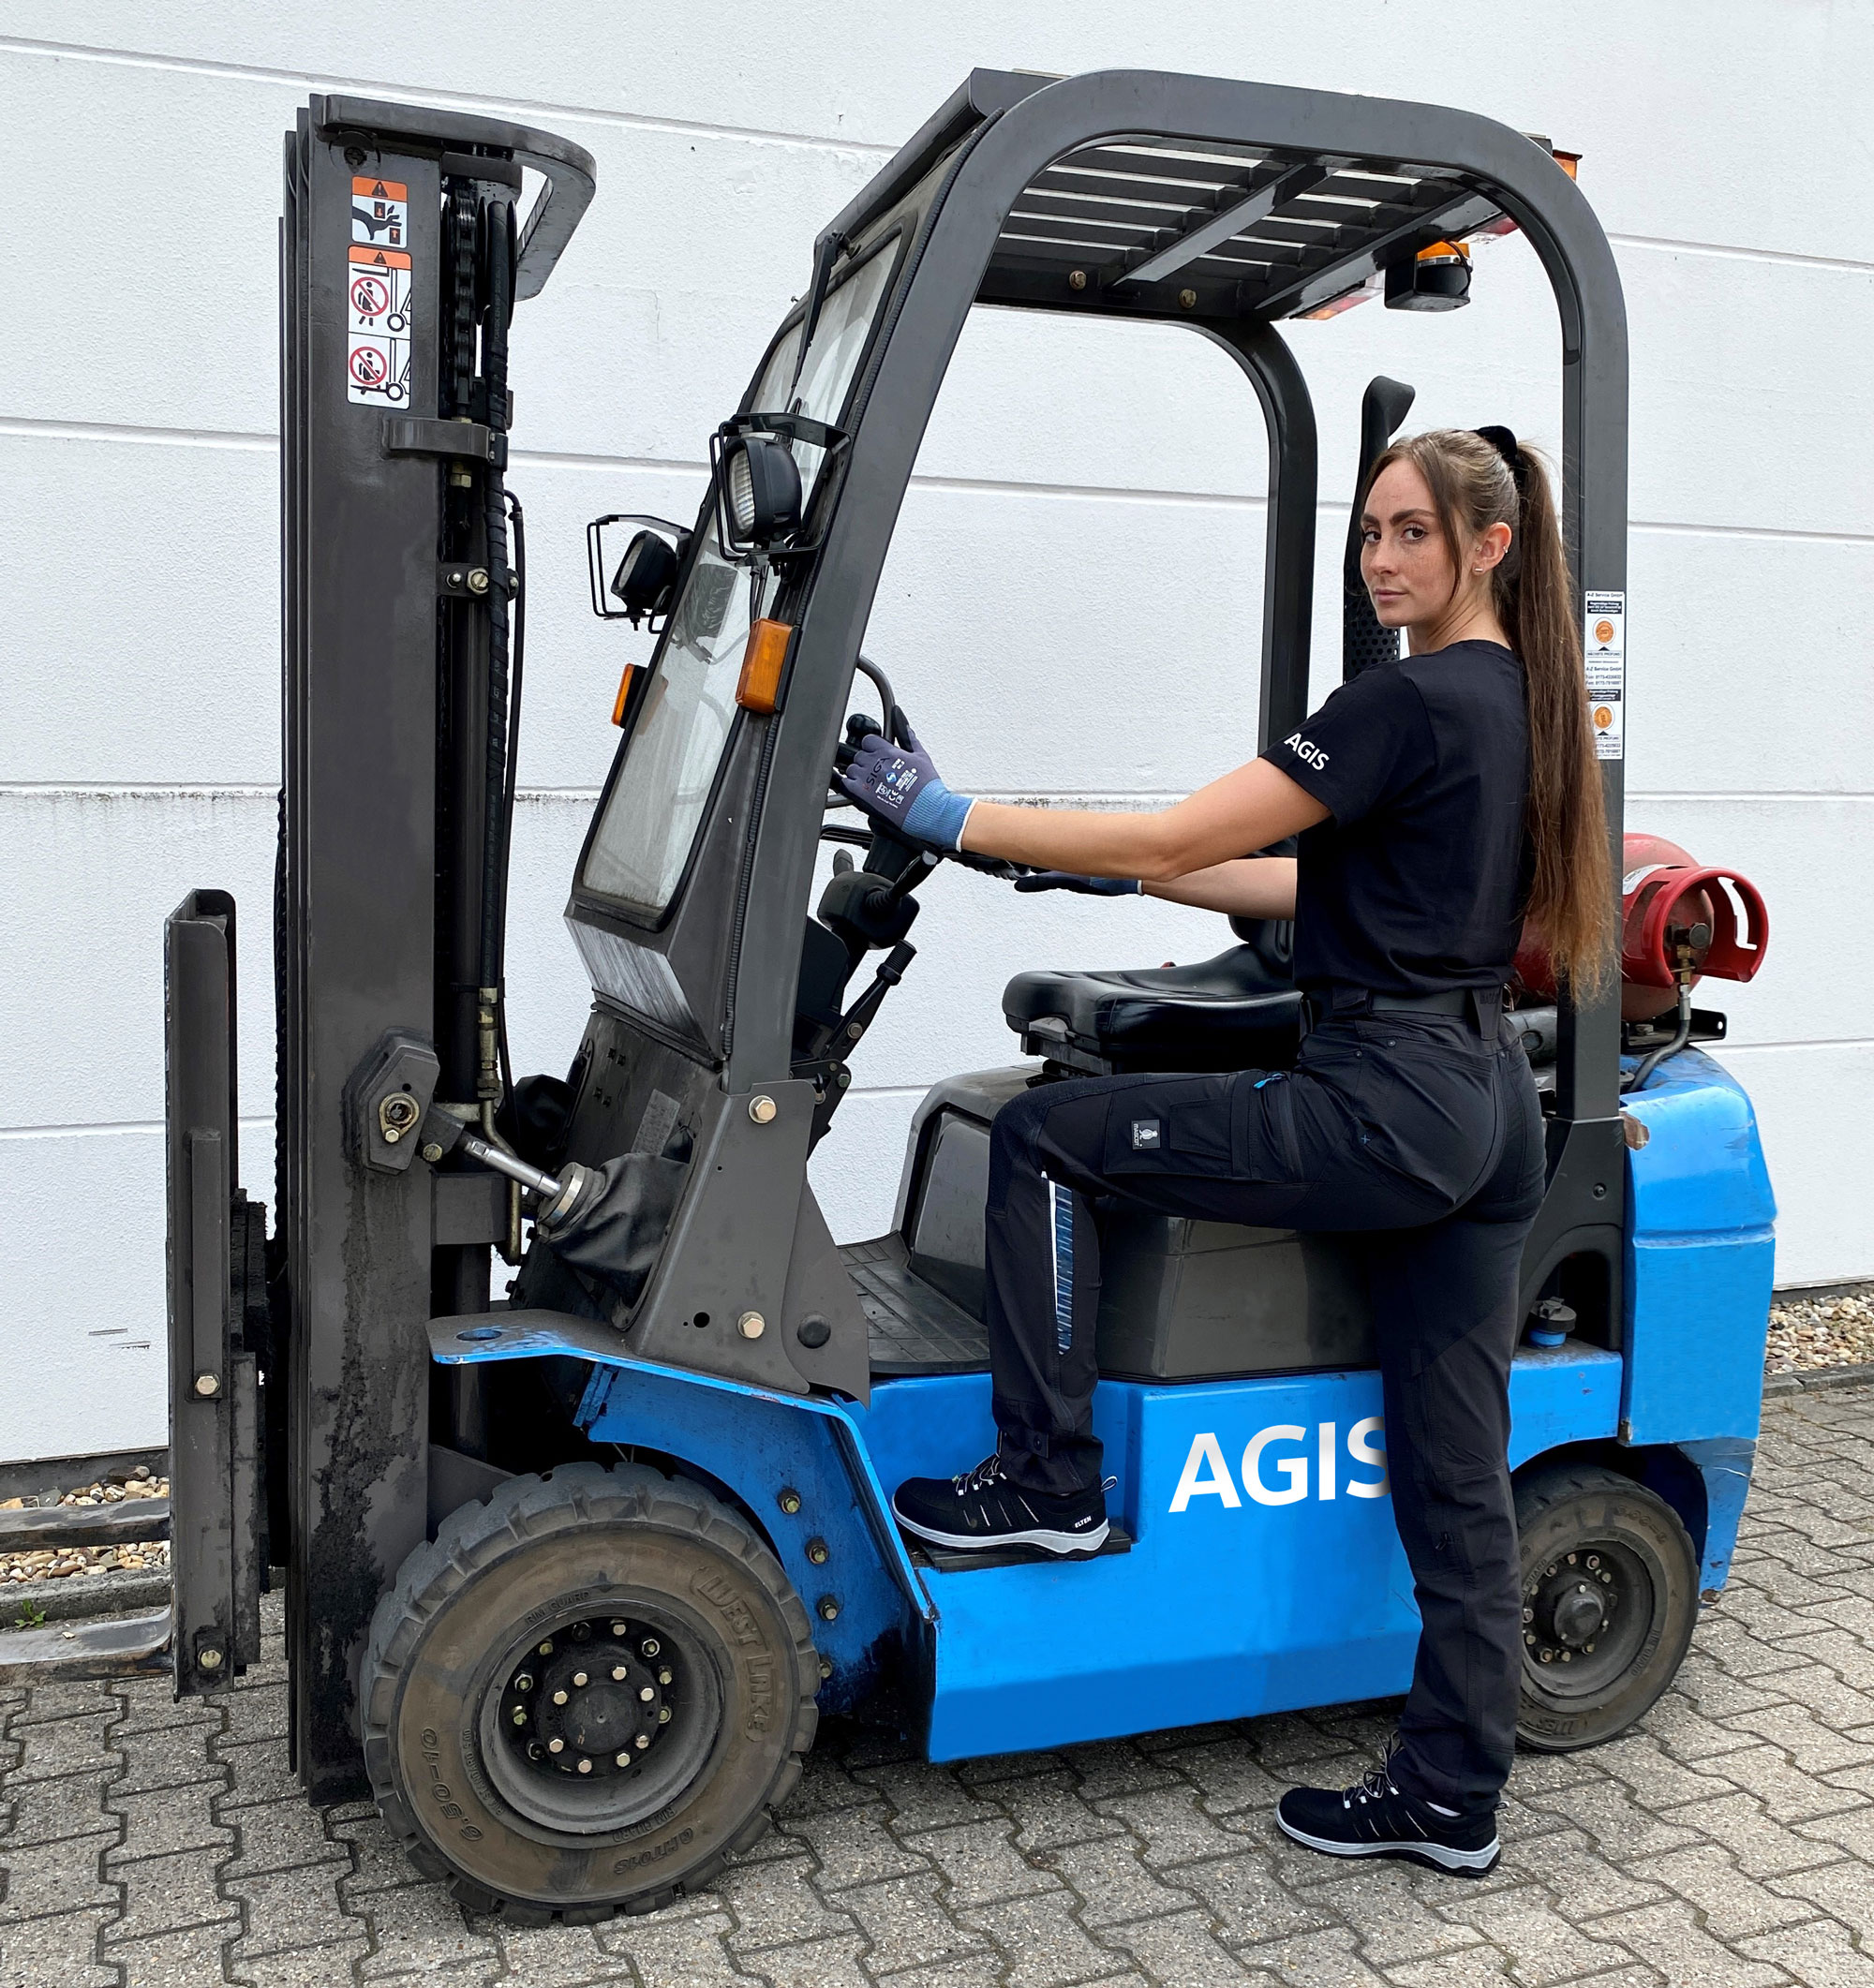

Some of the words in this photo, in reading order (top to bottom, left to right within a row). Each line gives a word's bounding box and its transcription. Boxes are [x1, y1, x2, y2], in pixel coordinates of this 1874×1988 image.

[1283, 733, 1330, 770] AGIS
[1168, 1416, 1392, 1513] AGIS
[1074, 1515, 1092, 1528] ELTEN
[526, 1609, 545, 1625] RIM
[549, 1590, 590, 1610] GUARD
[696, 1574, 765, 1646] WEST
[745, 1654, 773, 1732] LAKE
[421, 1726, 483, 1842] 6.50-10
